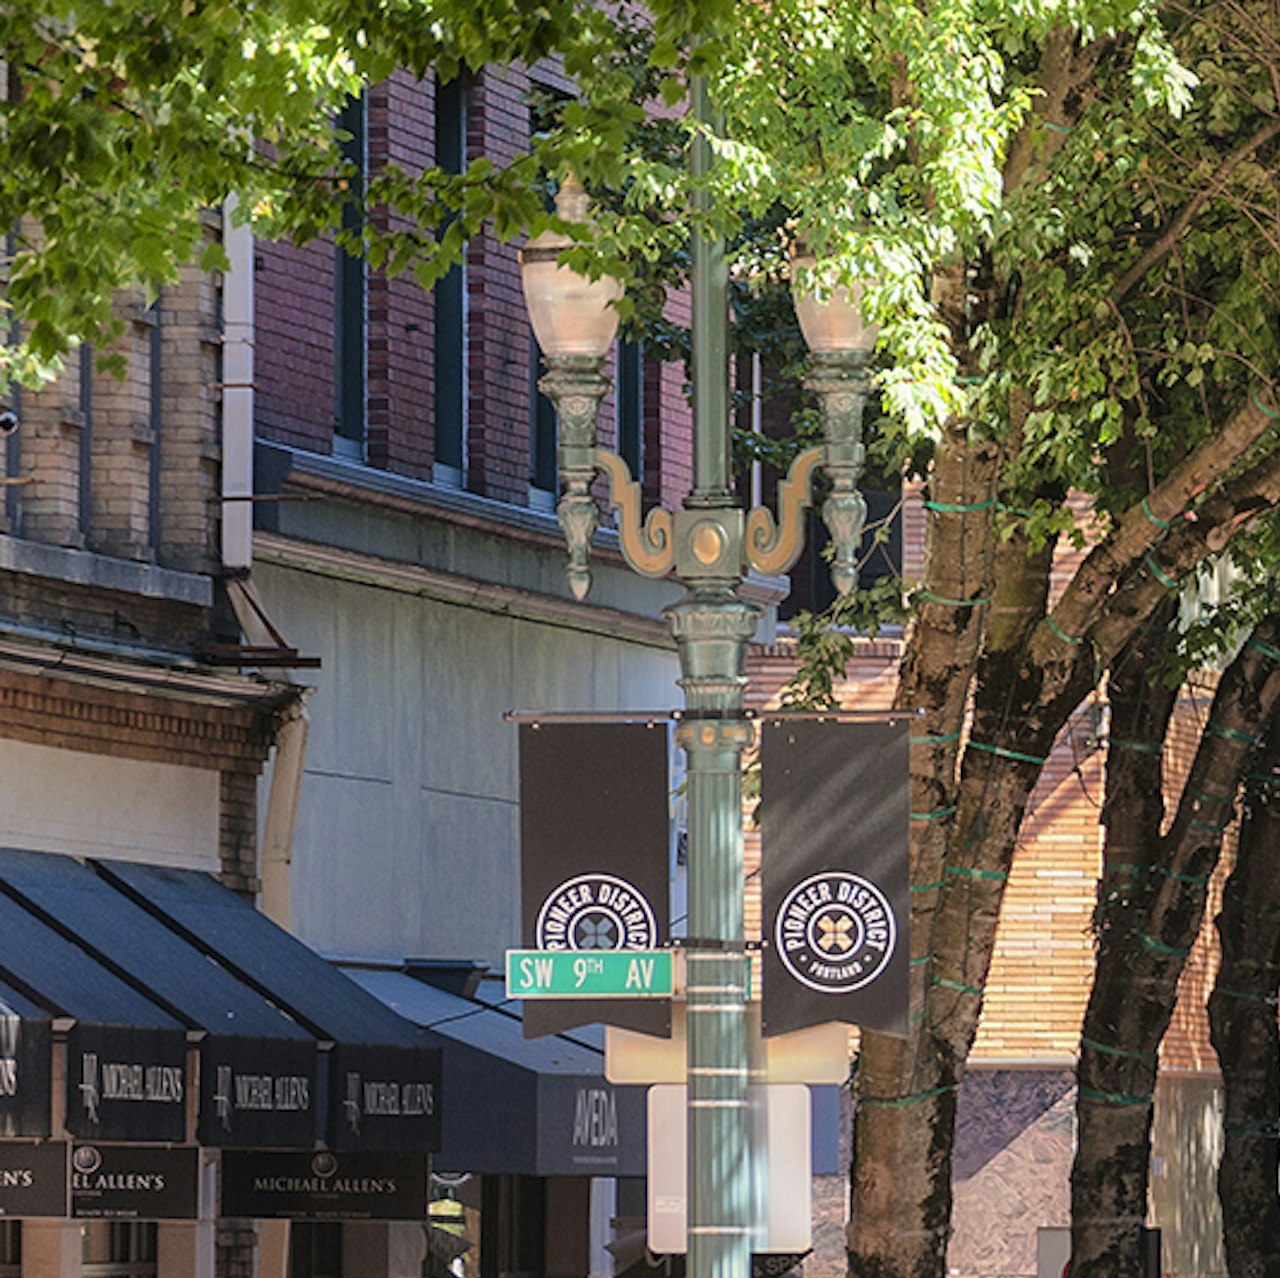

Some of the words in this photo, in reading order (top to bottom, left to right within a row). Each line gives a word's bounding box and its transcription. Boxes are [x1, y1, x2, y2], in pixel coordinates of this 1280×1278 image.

[783, 881, 832, 951] PIONEER
[837, 882, 888, 952] DISTRICT
[519, 957, 553, 988] SW
[573, 958, 603, 992] 9TH
[626, 959, 654, 989] AV
[572, 1090, 618, 1146] AVEDA
[95, 1175, 165, 1192] ALLEN'S
[254, 1177, 328, 1192] MICHAEL
[332, 1178, 398, 1193] ALLEN'S
